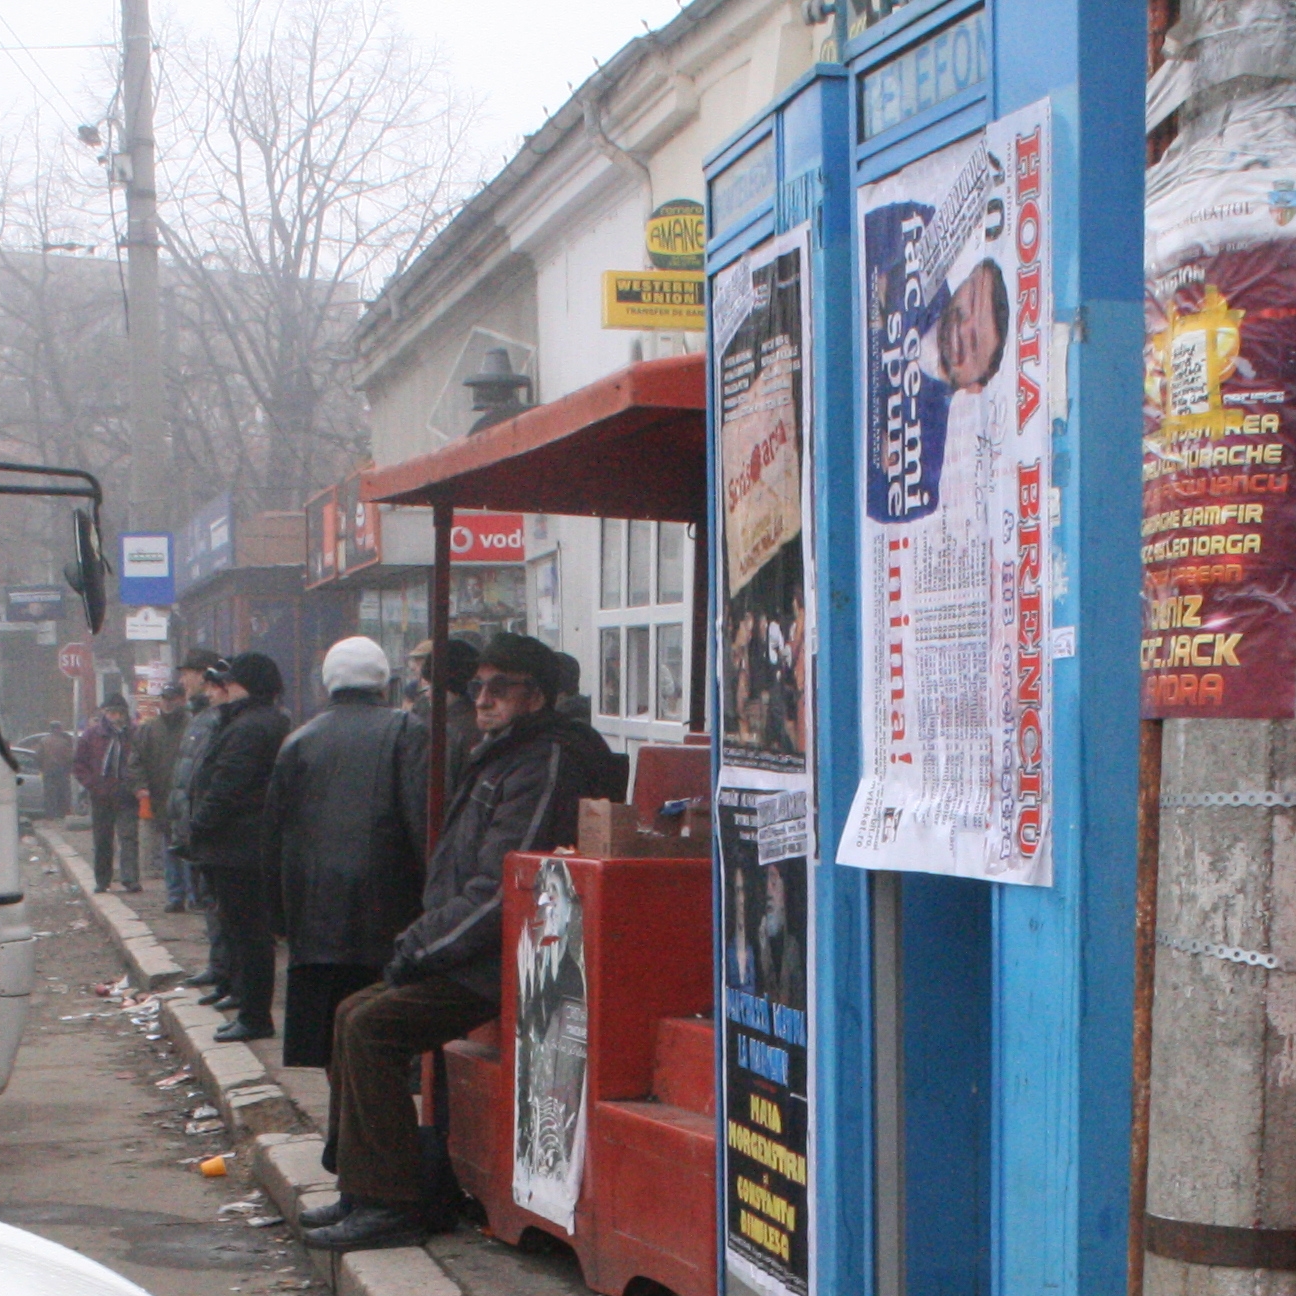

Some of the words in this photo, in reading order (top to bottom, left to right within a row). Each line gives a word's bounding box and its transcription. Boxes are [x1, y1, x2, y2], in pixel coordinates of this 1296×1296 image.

[651, 217, 706, 252] AMANE
[902, 211, 925, 311] fac
[617, 280, 695, 293] WESTERN
[1015, 124, 1042, 435] HORIA
[641, 291, 695, 305] UNION
[882, 311, 903, 518] spune
[903, 327, 929, 516] ce-mi
[1182, 504, 1264, 528] ZAMFIR
[479, 527, 525, 549] vod
[1192, 533, 1262, 557] IORGA
[1016, 457, 1045, 860] BRENCIU
